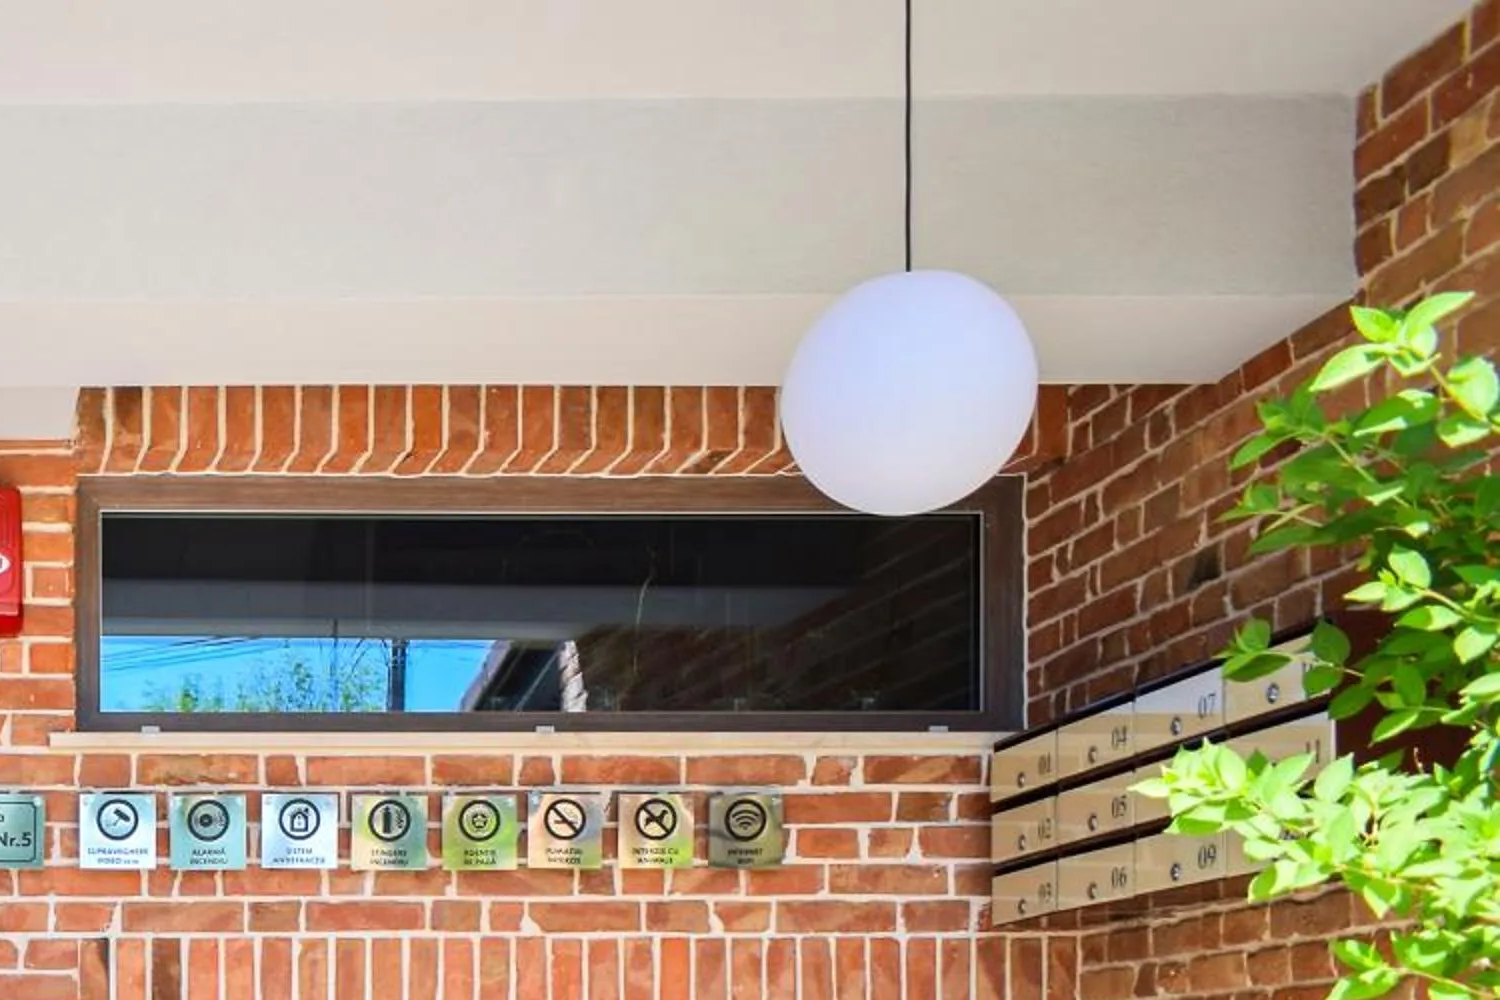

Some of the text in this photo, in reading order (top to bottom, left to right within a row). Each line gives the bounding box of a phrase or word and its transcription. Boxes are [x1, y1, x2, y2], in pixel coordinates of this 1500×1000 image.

[1198, 694, 1216, 718] 07
[1111, 726, 1127, 749] 04
[1111, 795, 1127, 818] 05
[1198, 844, 1217, 869] 09
[1111, 865, 1127, 889] 06
